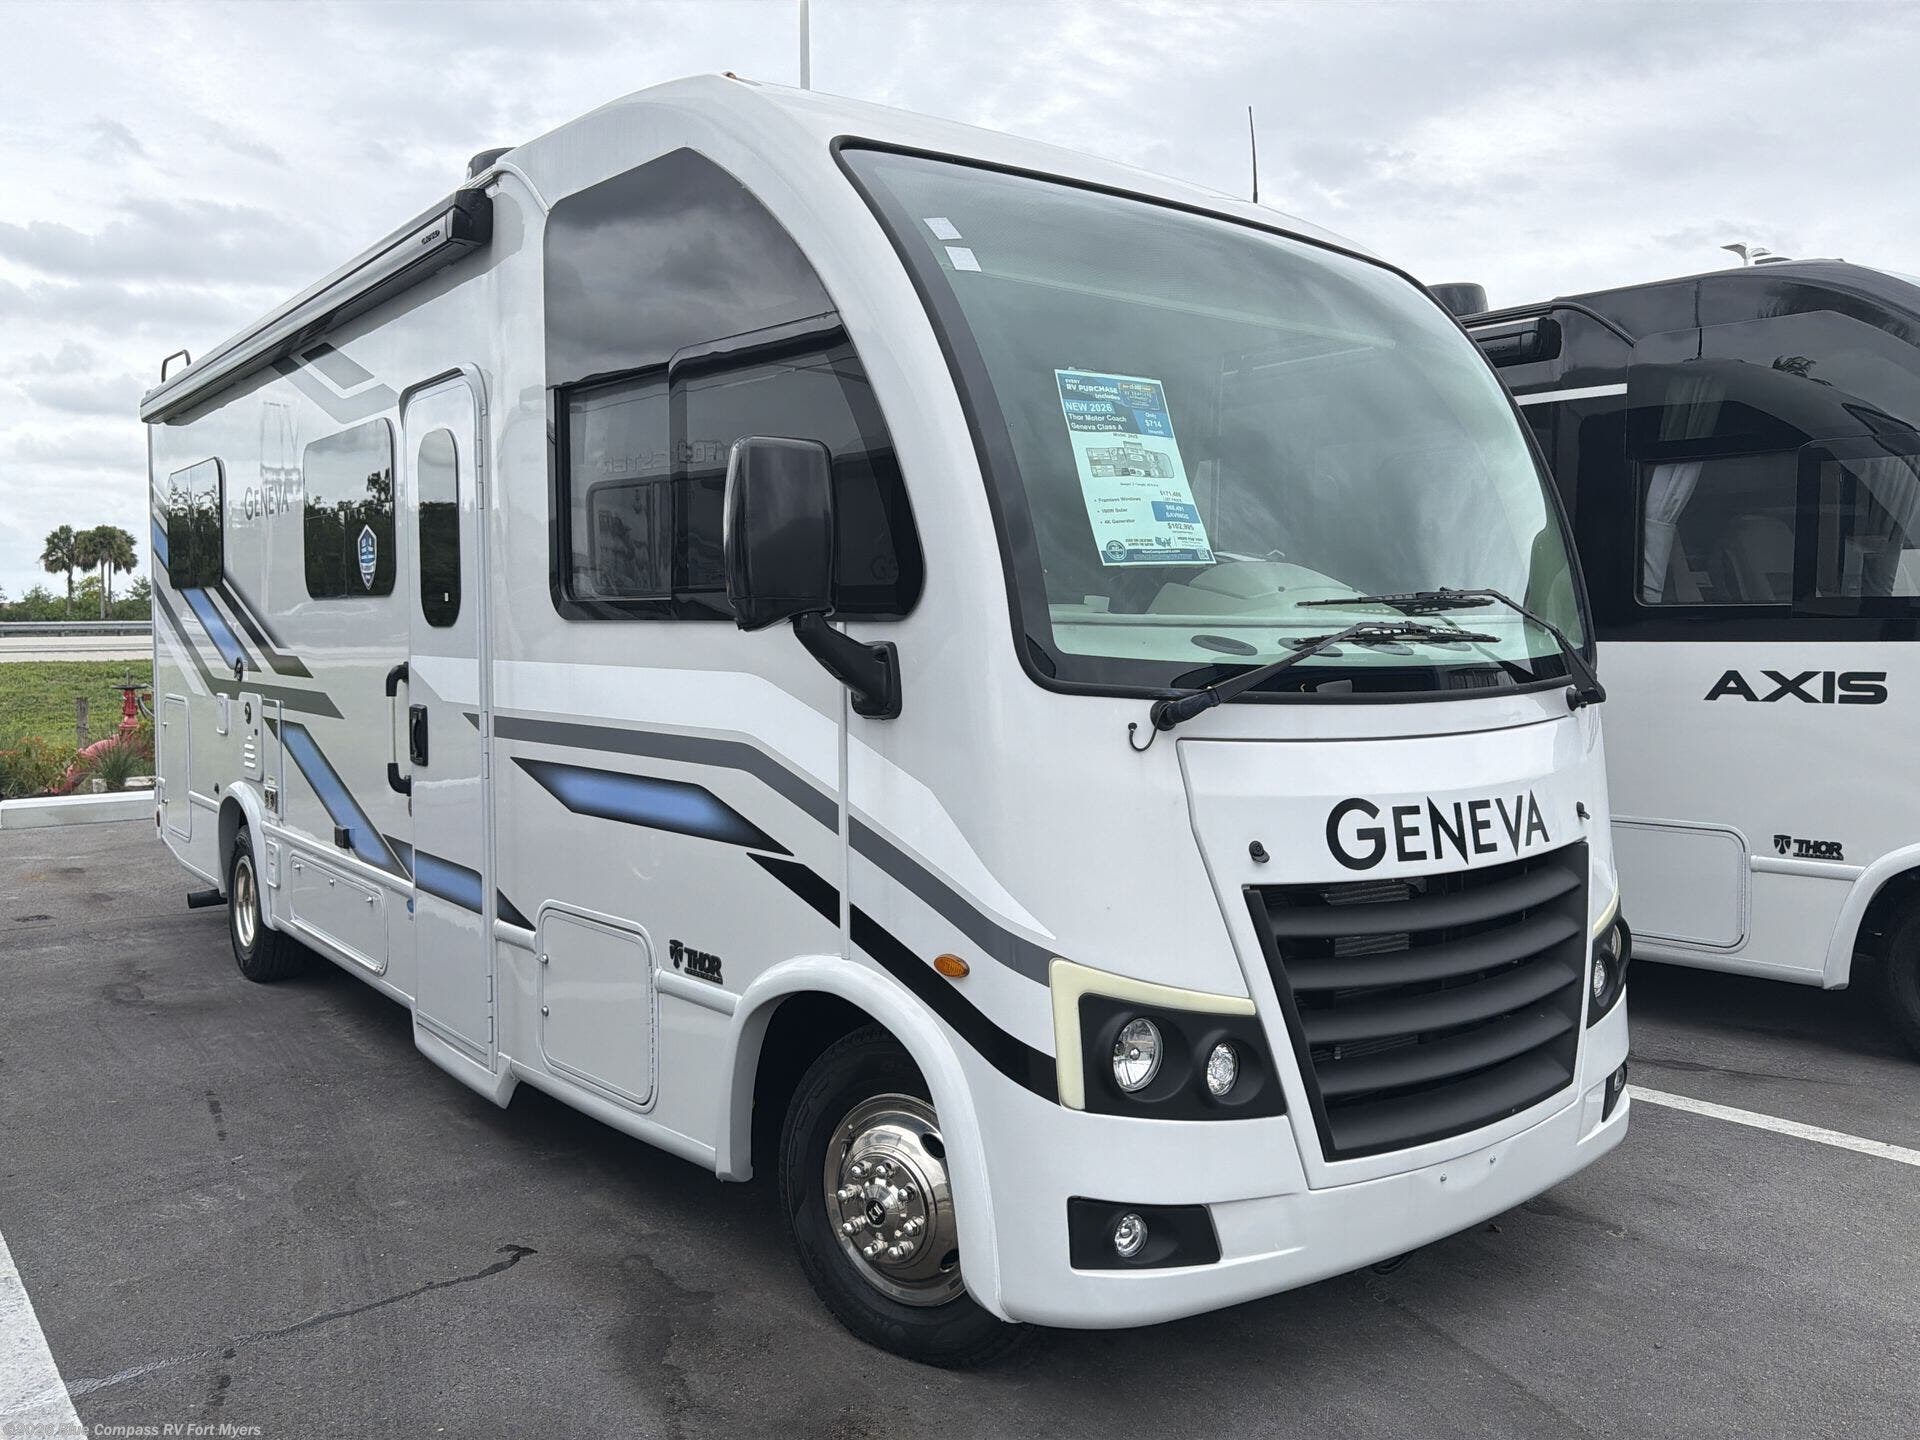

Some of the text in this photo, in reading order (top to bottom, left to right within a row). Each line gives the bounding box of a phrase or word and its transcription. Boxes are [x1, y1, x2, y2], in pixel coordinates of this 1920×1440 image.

[1066, 383, 1119, 394] RV PURCHASE
[1065, 400, 1113, 412] NEW 2026
[1068, 413, 1084, 421] Thor
[1106, 414, 1128, 423] Coach
[1144, 419, 1163, 428] $714
[1071, 422, 1096, 430] Geneva
[1097, 423, 1117, 431] Class
[244, 486, 290, 521] GENEVA
[1703, 669, 1888, 705] AXIS
[1325, 788, 1550, 871] GENEVA
[1793, 838, 1843, 858] THOR
[683, 946, 723, 979] THOR
